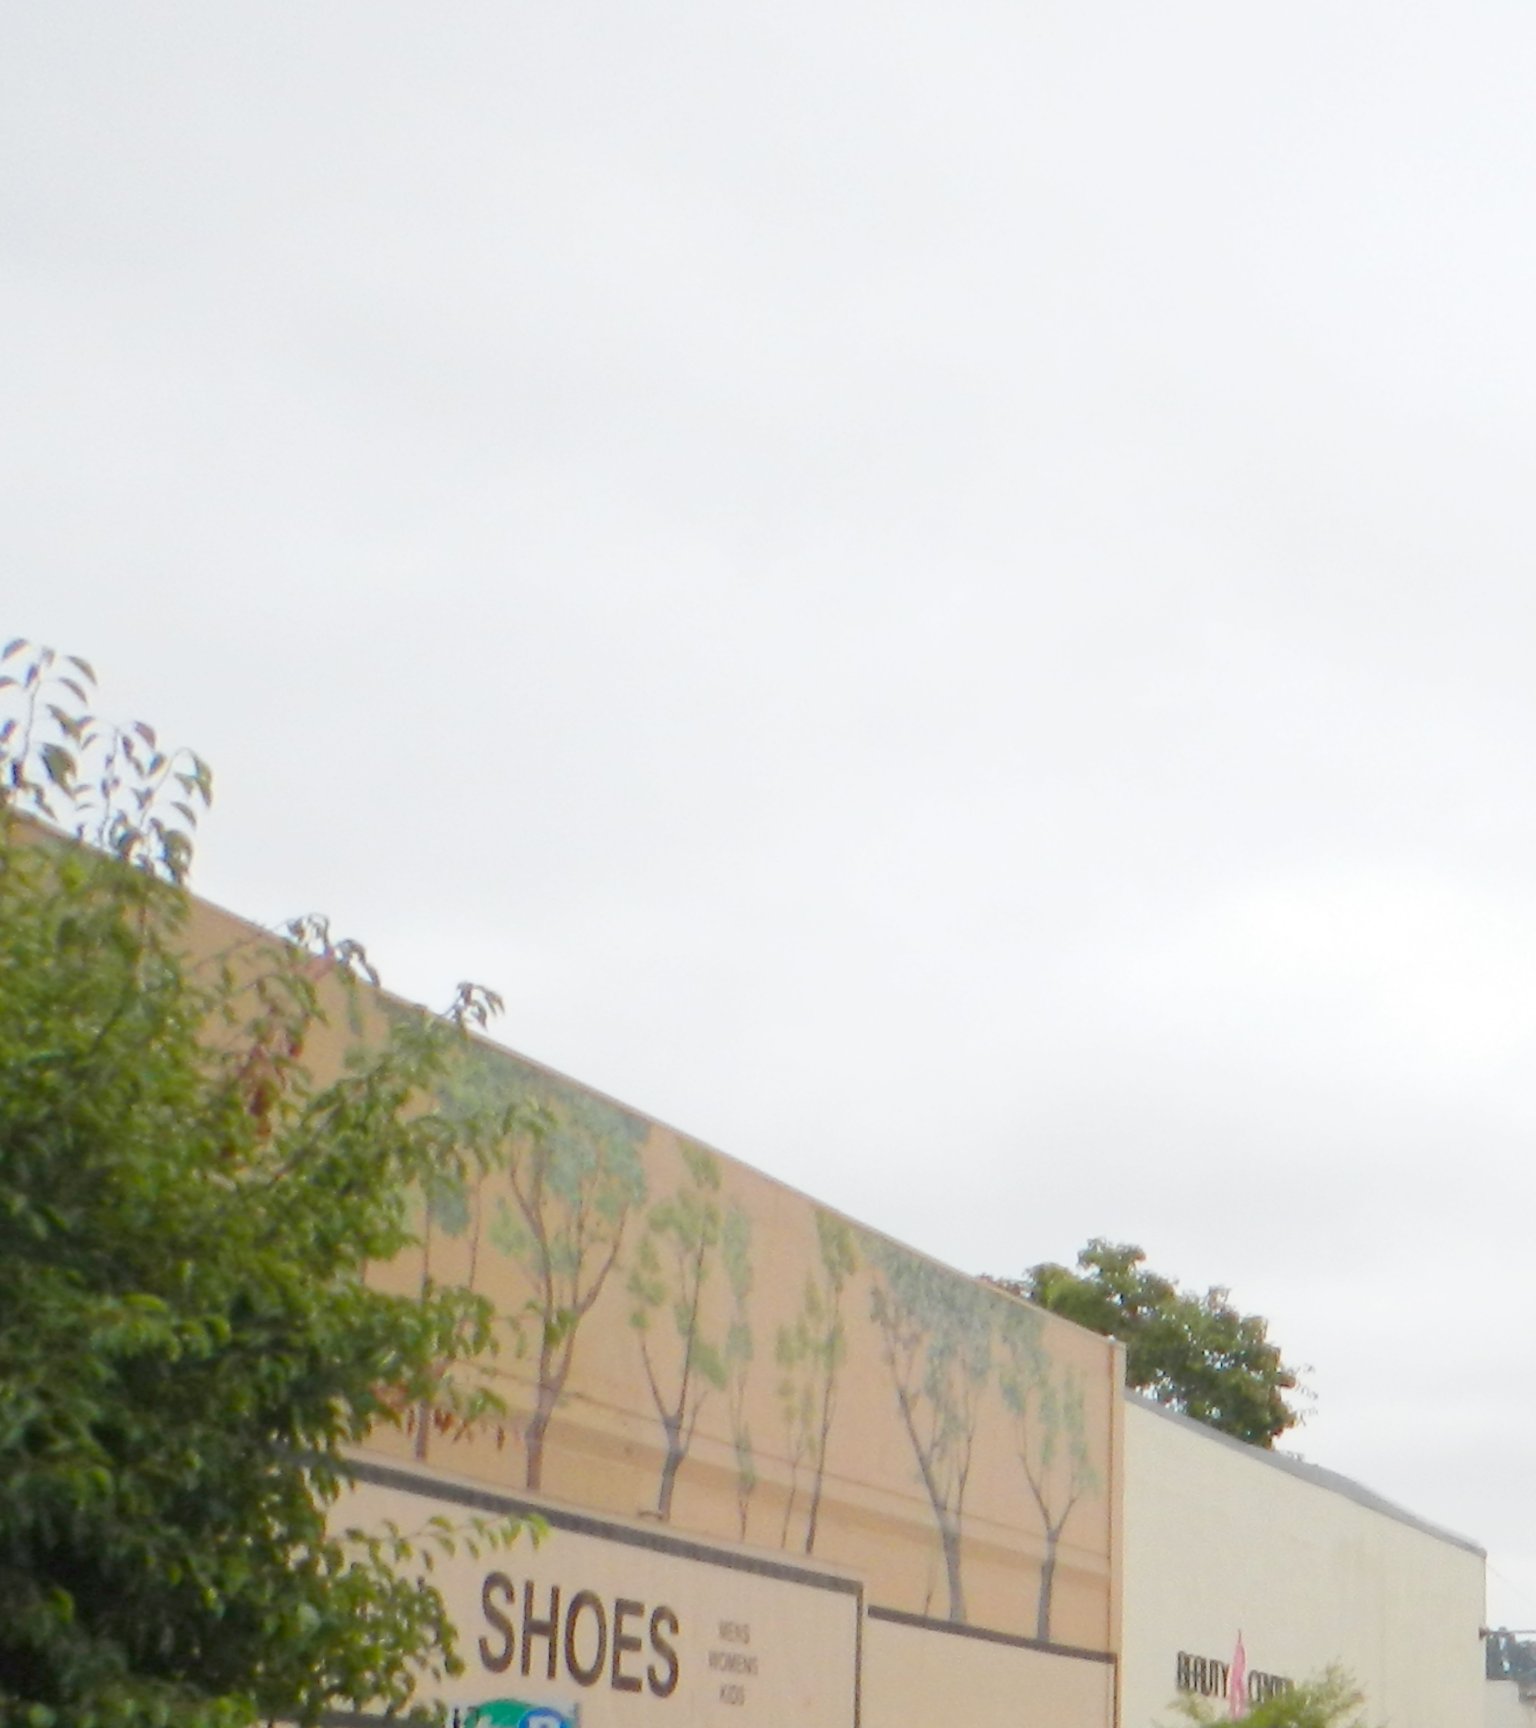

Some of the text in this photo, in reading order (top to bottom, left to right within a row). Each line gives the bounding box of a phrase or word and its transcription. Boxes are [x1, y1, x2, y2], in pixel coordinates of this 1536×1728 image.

[479, 1571, 679, 1698] SHOES
[708, 1651, 759, 1675] WOMENS
[1177, 1650, 1230, 1698] BEAUTY
